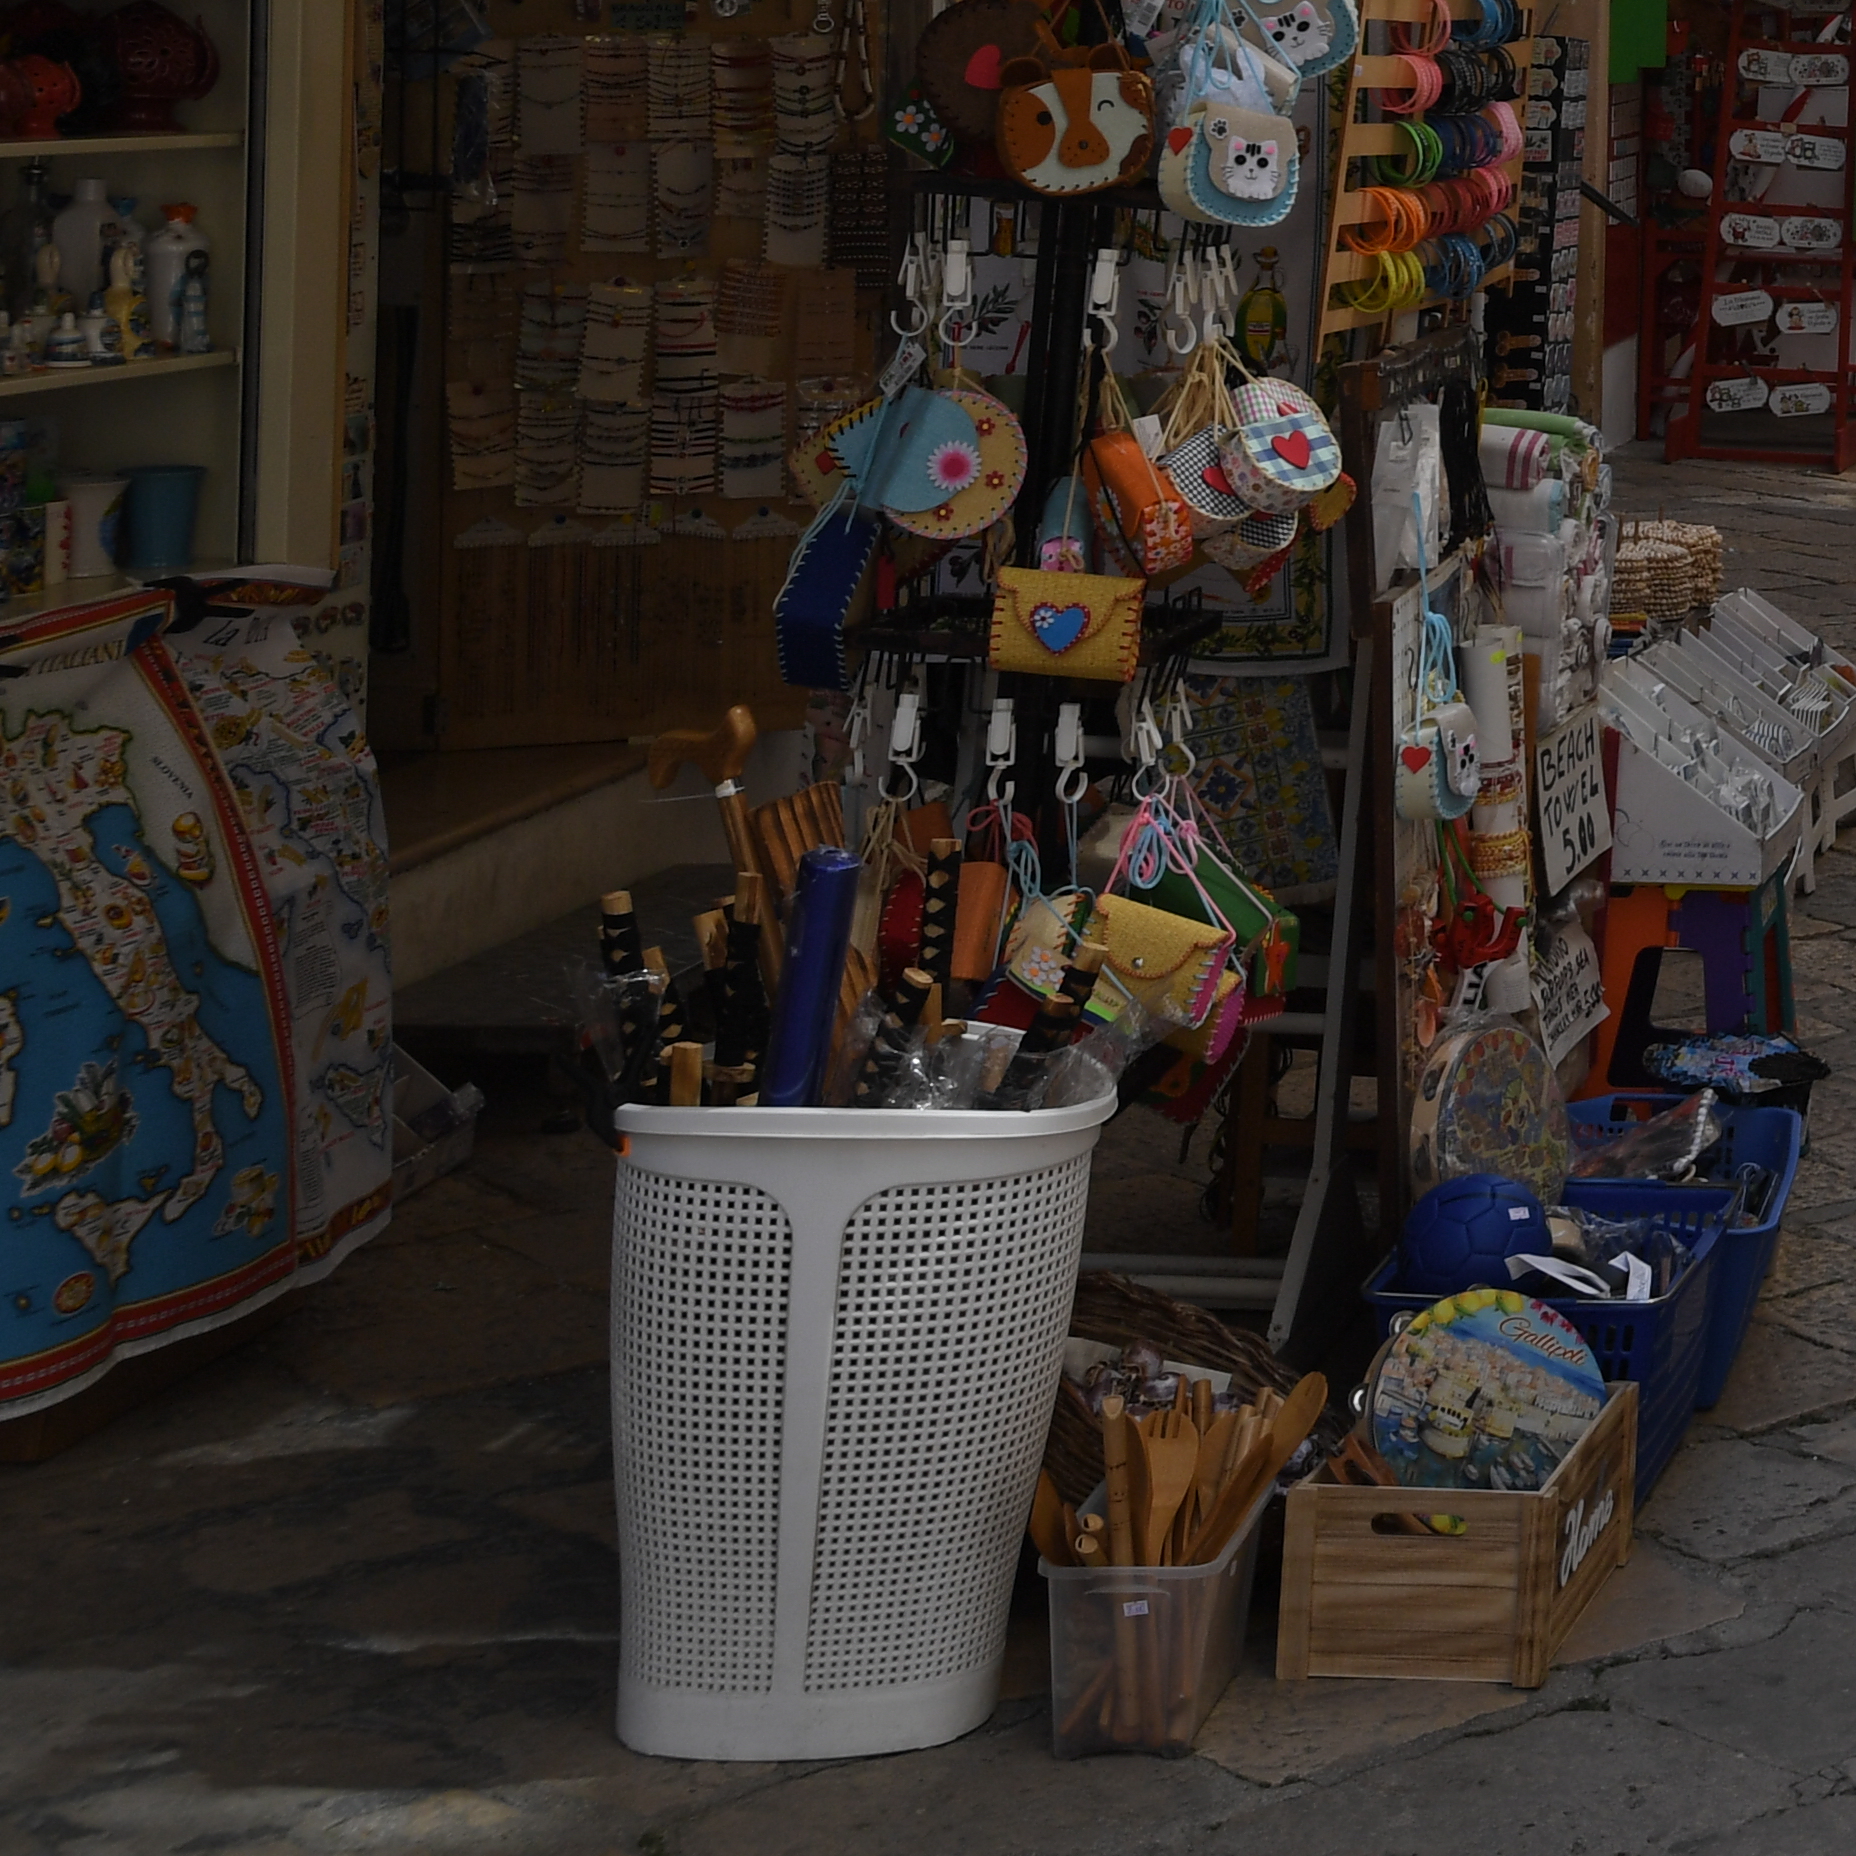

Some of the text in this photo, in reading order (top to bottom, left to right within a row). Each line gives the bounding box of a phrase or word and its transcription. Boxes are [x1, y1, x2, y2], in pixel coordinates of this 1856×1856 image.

[152, 755, 194, 799] SLOVENIA
[1540, 717, 1595, 792] BEACH
[1543, 765, 1599, 838] TOWEL
[1562, 811, 1596, 876] 5.00
[1498, 1316, 1588, 1367] Gallipoli
